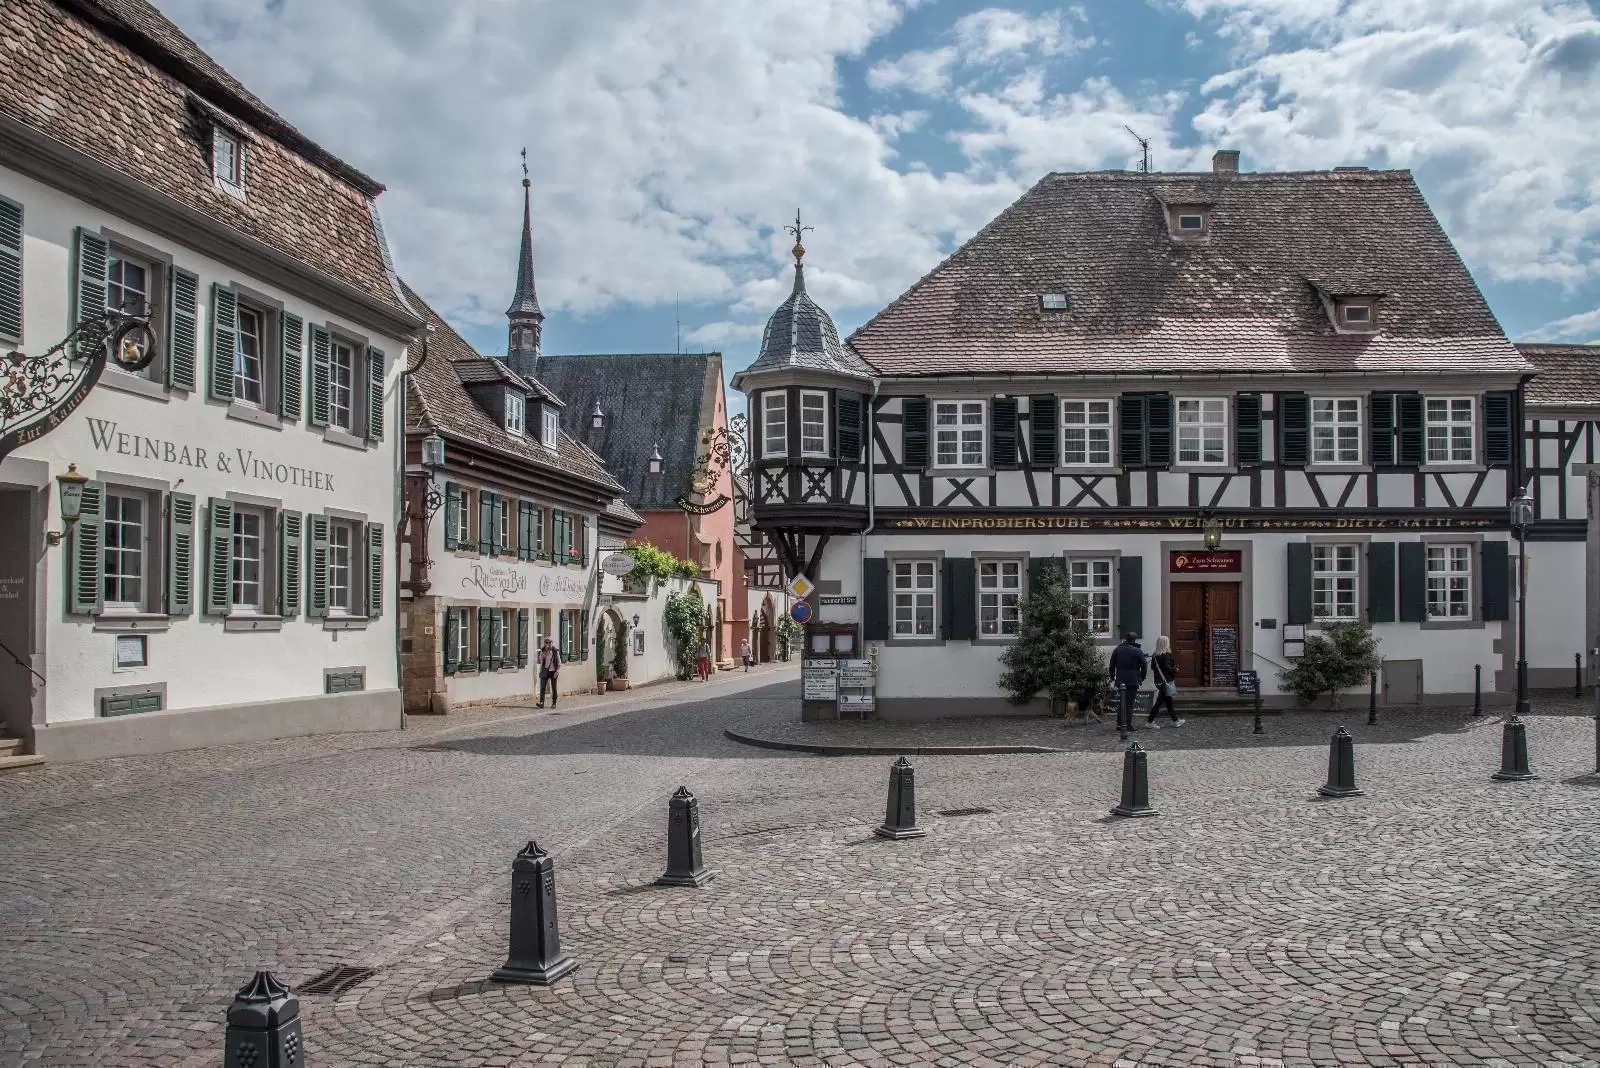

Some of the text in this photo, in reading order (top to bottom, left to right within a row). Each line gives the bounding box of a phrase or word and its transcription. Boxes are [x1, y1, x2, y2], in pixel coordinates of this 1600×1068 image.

[17, 385, 88, 444] Zur Kanne
[85, 416, 335, 492] WEINBAR & VINOTHEK
[678, 498, 725, 514] Zum Schwanen
[912, 517, 1090, 529] WEINPROBIERSTUBE
[1192, 556, 1234, 564] Zum Schwanen
